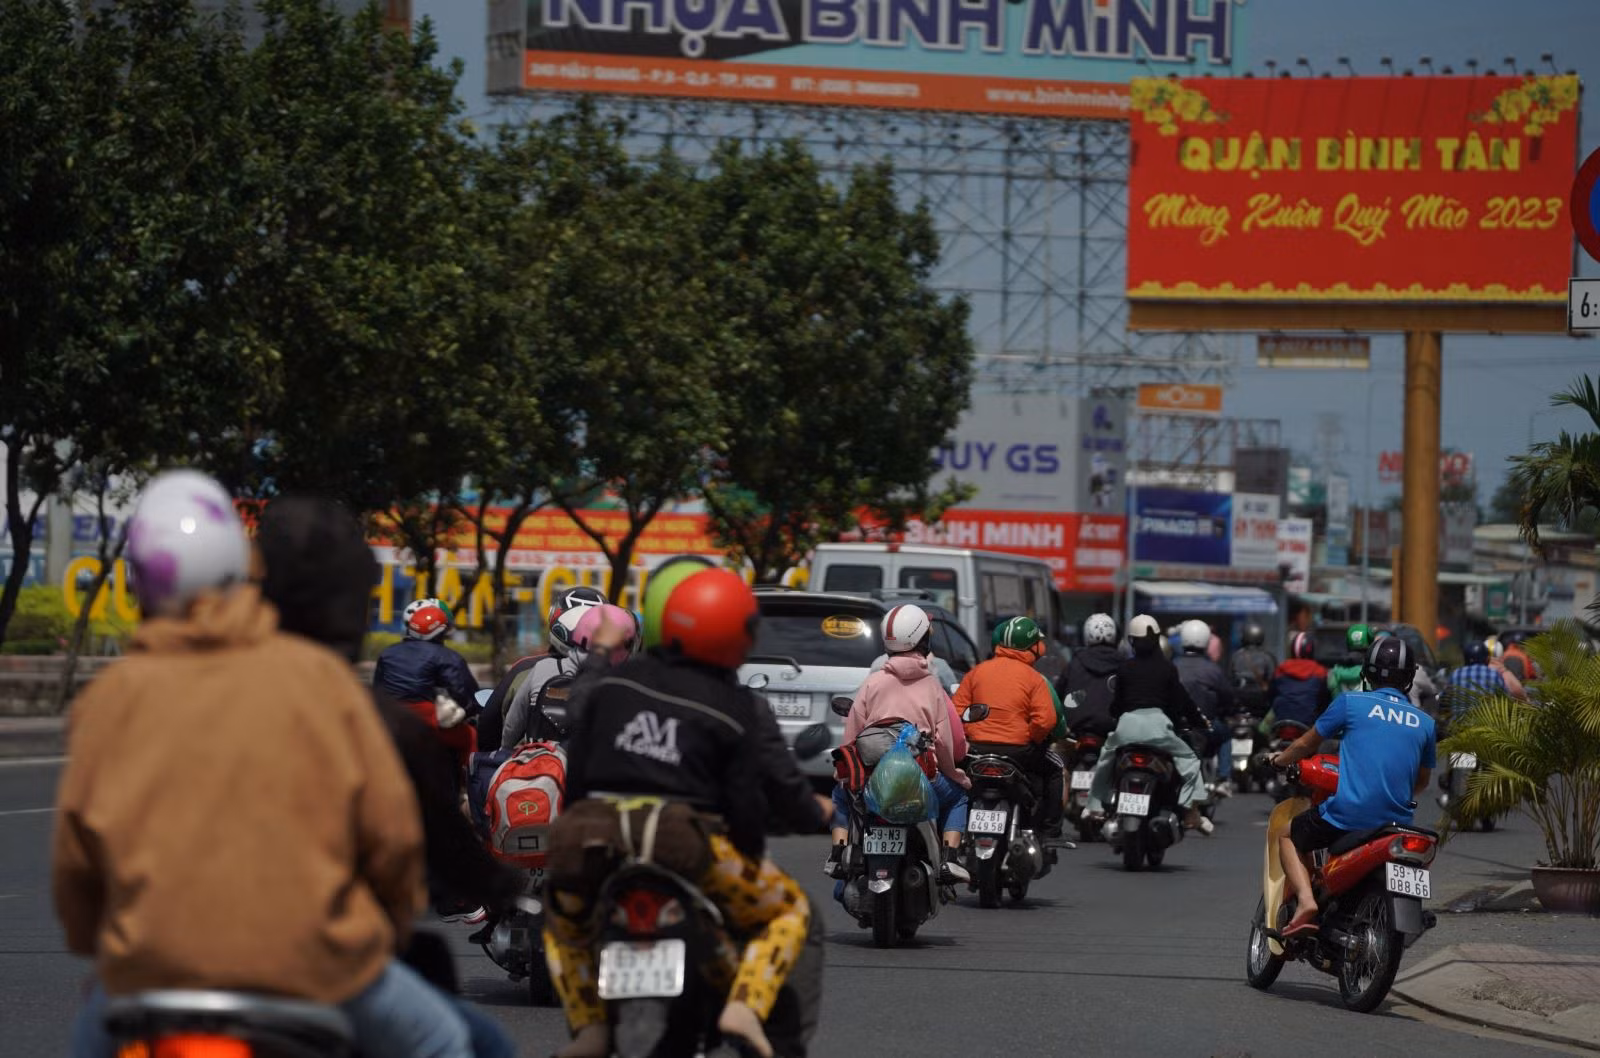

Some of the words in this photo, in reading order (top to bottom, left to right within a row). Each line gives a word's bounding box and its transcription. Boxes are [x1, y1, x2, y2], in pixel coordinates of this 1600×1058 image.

[1179, 130, 1302, 180] QUẬN
[1317, 129, 1421, 171] BÌNH
[1435, 130, 1521, 171] TÂN
[1242, 193, 1323, 233] Xuân
[1333, 193, 1390, 246] Quý
[1479, 197, 1563, 230] 2023
[1005, 443, 1060, 474] GS
[983, 521, 1065, 548] MINH
[1367, 704, 1420, 728] AND
[975, 811, 1001, 822] 62-B1
[866, 840, 904, 853] 018.27
[871, 828, 901, 841] 59-N3
[1390, 877, 1429, 897] 088.66
